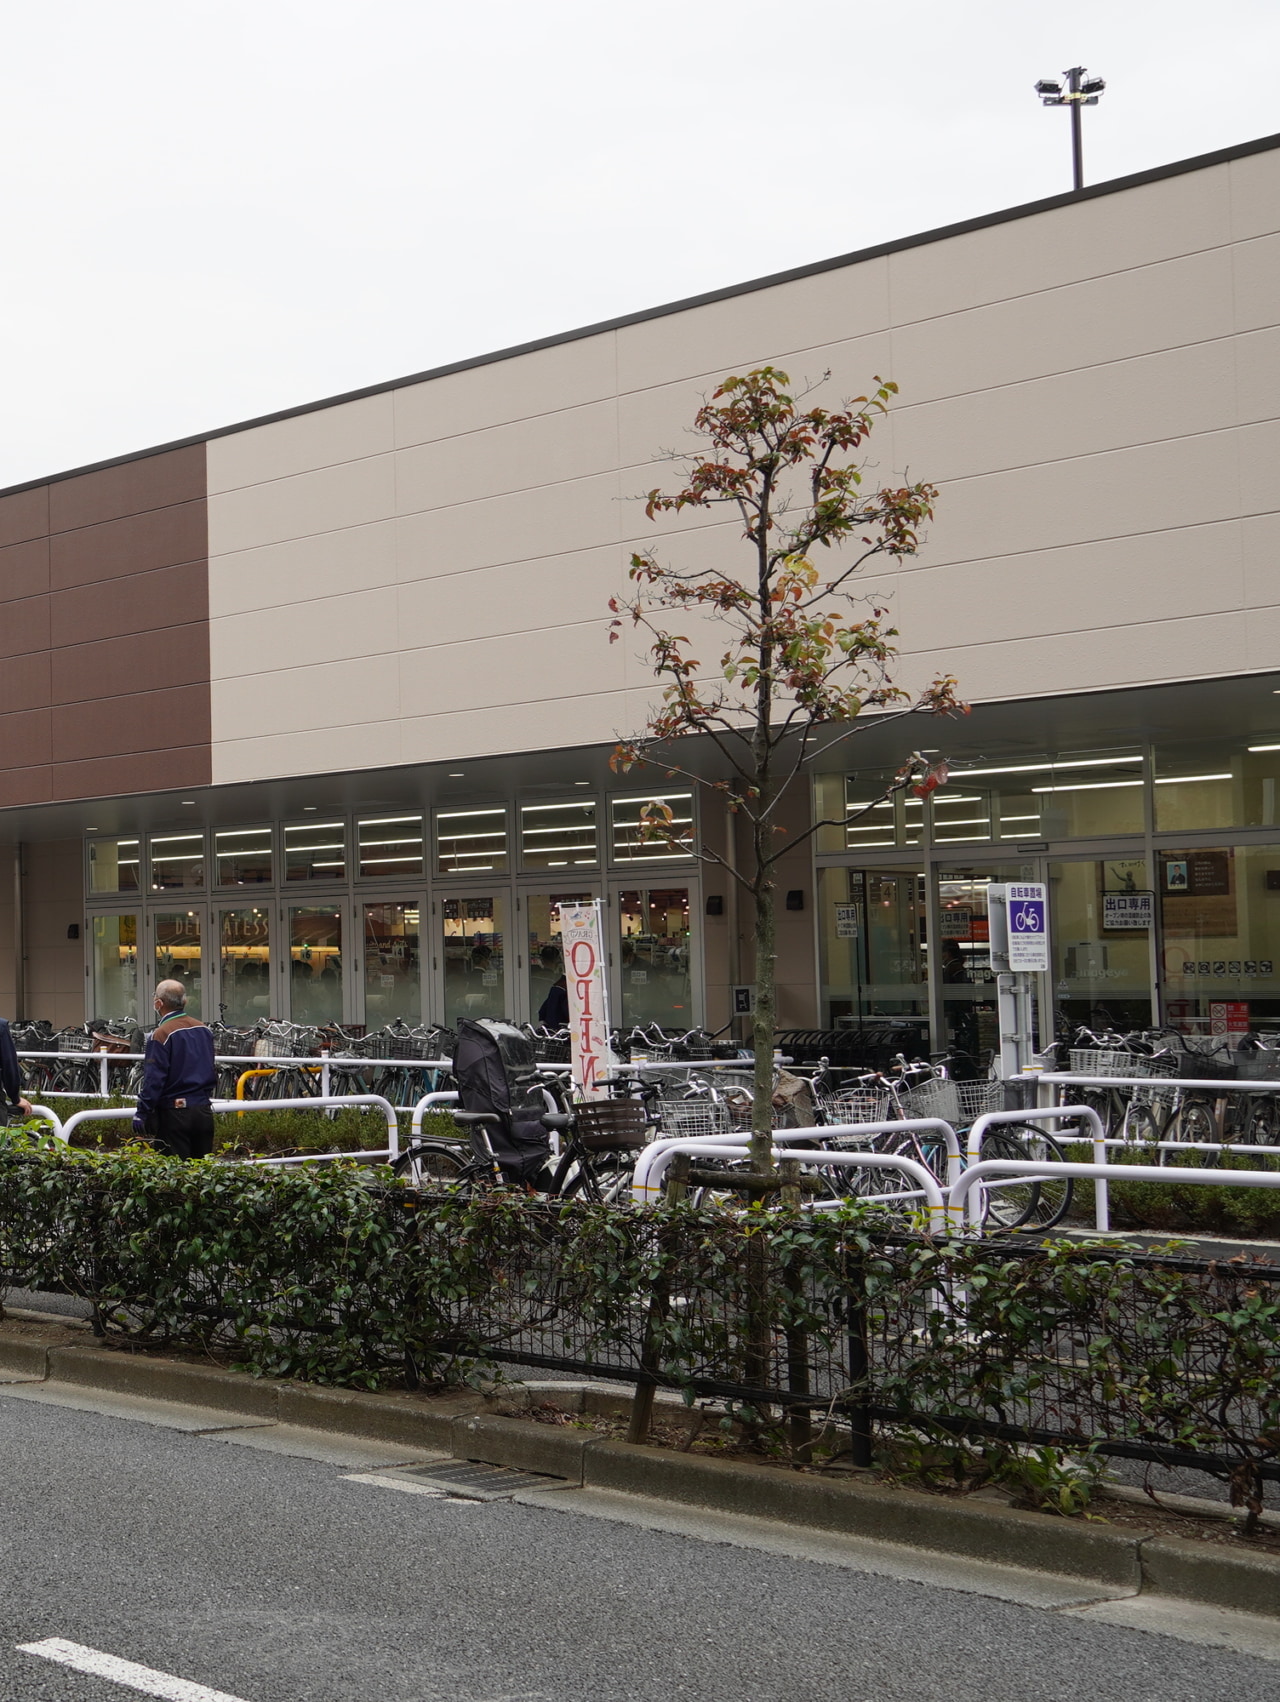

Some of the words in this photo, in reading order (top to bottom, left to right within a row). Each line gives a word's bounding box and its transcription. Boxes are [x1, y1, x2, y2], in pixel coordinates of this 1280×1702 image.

[1010, 887, 1042, 899] 自転車置場
[1105, 898, 1151, 911] 出口専用
